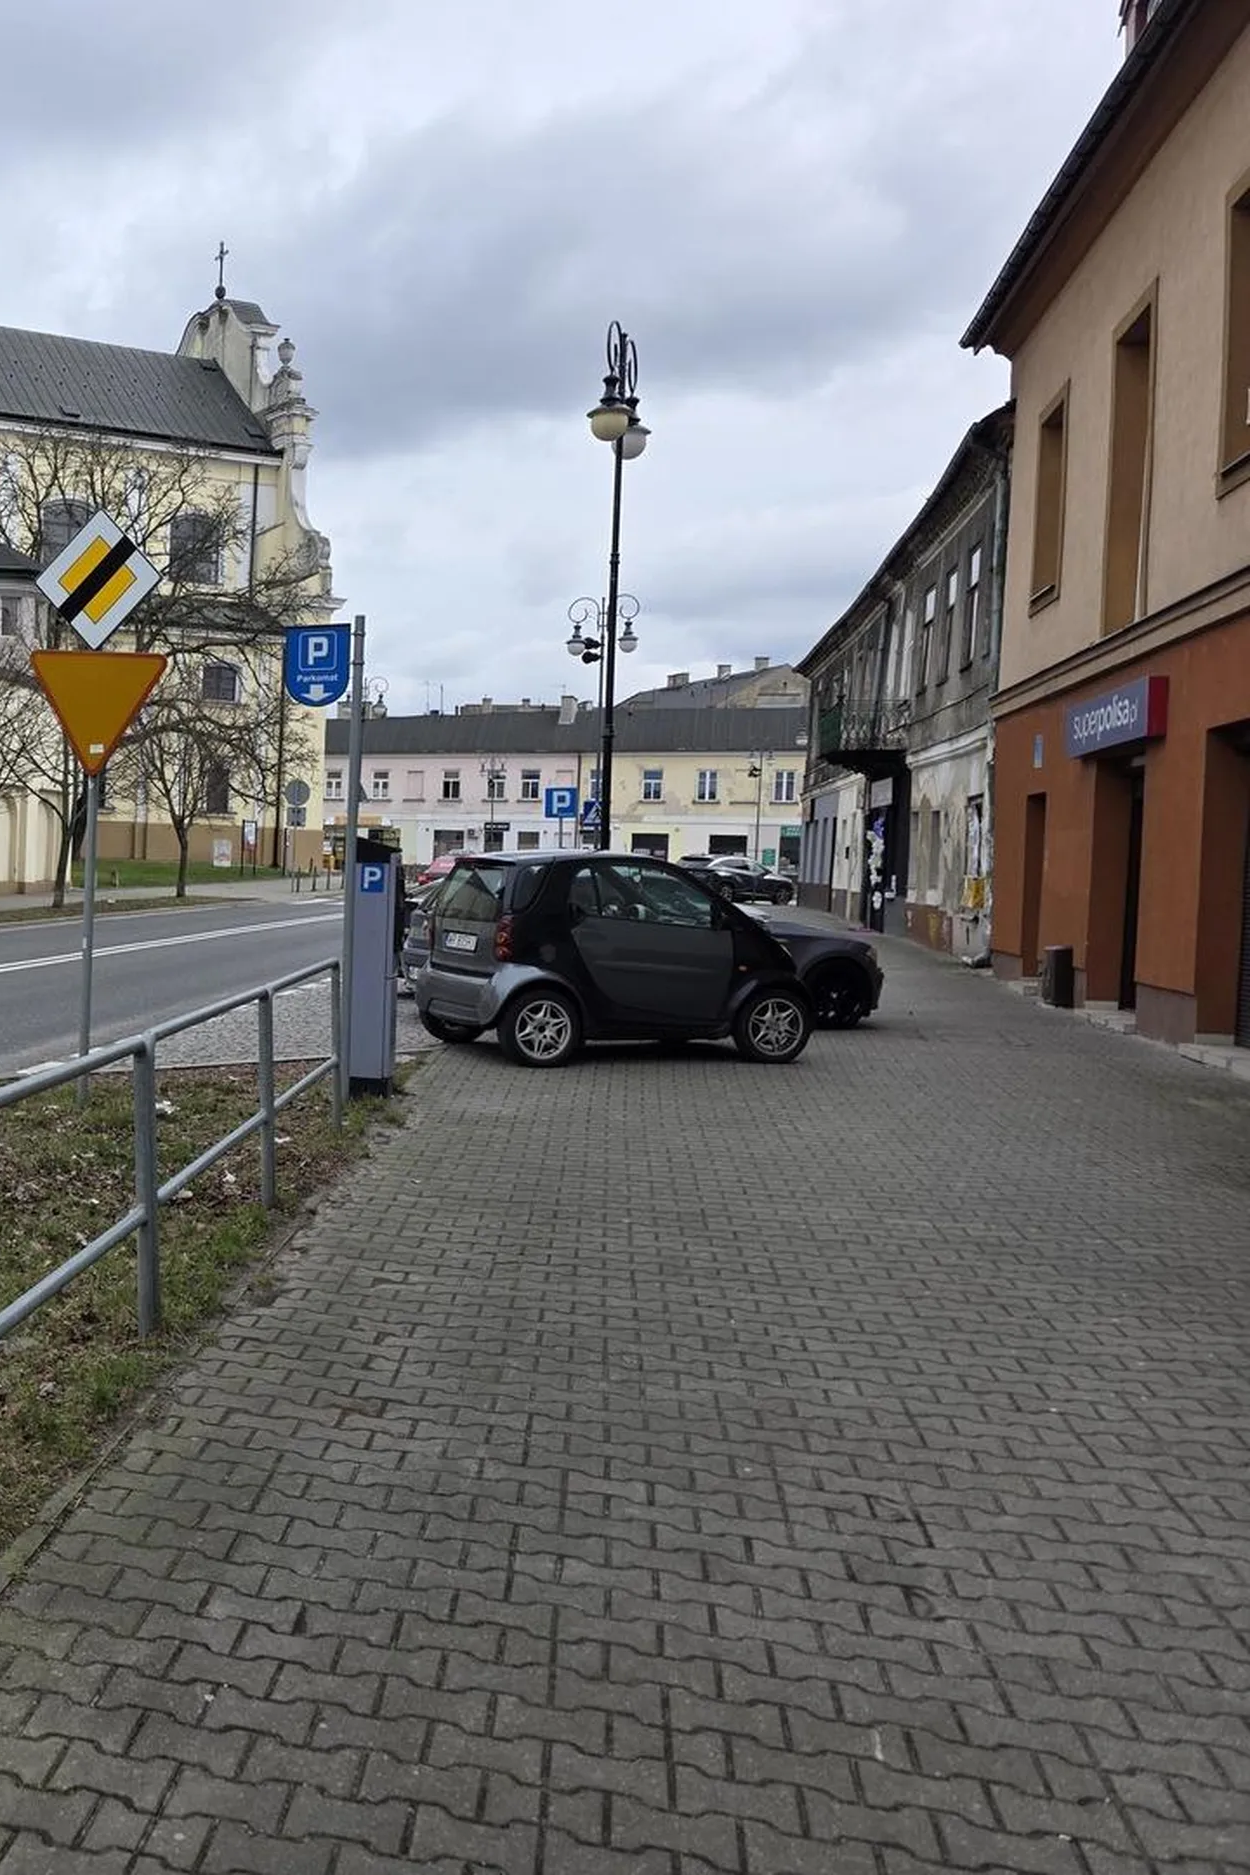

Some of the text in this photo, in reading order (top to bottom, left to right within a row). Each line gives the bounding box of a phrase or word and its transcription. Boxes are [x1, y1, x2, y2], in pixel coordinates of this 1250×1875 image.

[308, 636, 329, 665] P
[296, 673, 339, 683] Parkomat
[1072, 694, 1139, 745] superpolisapl
[552, 790, 571, 815] P
[363, 866, 382, 889] P
